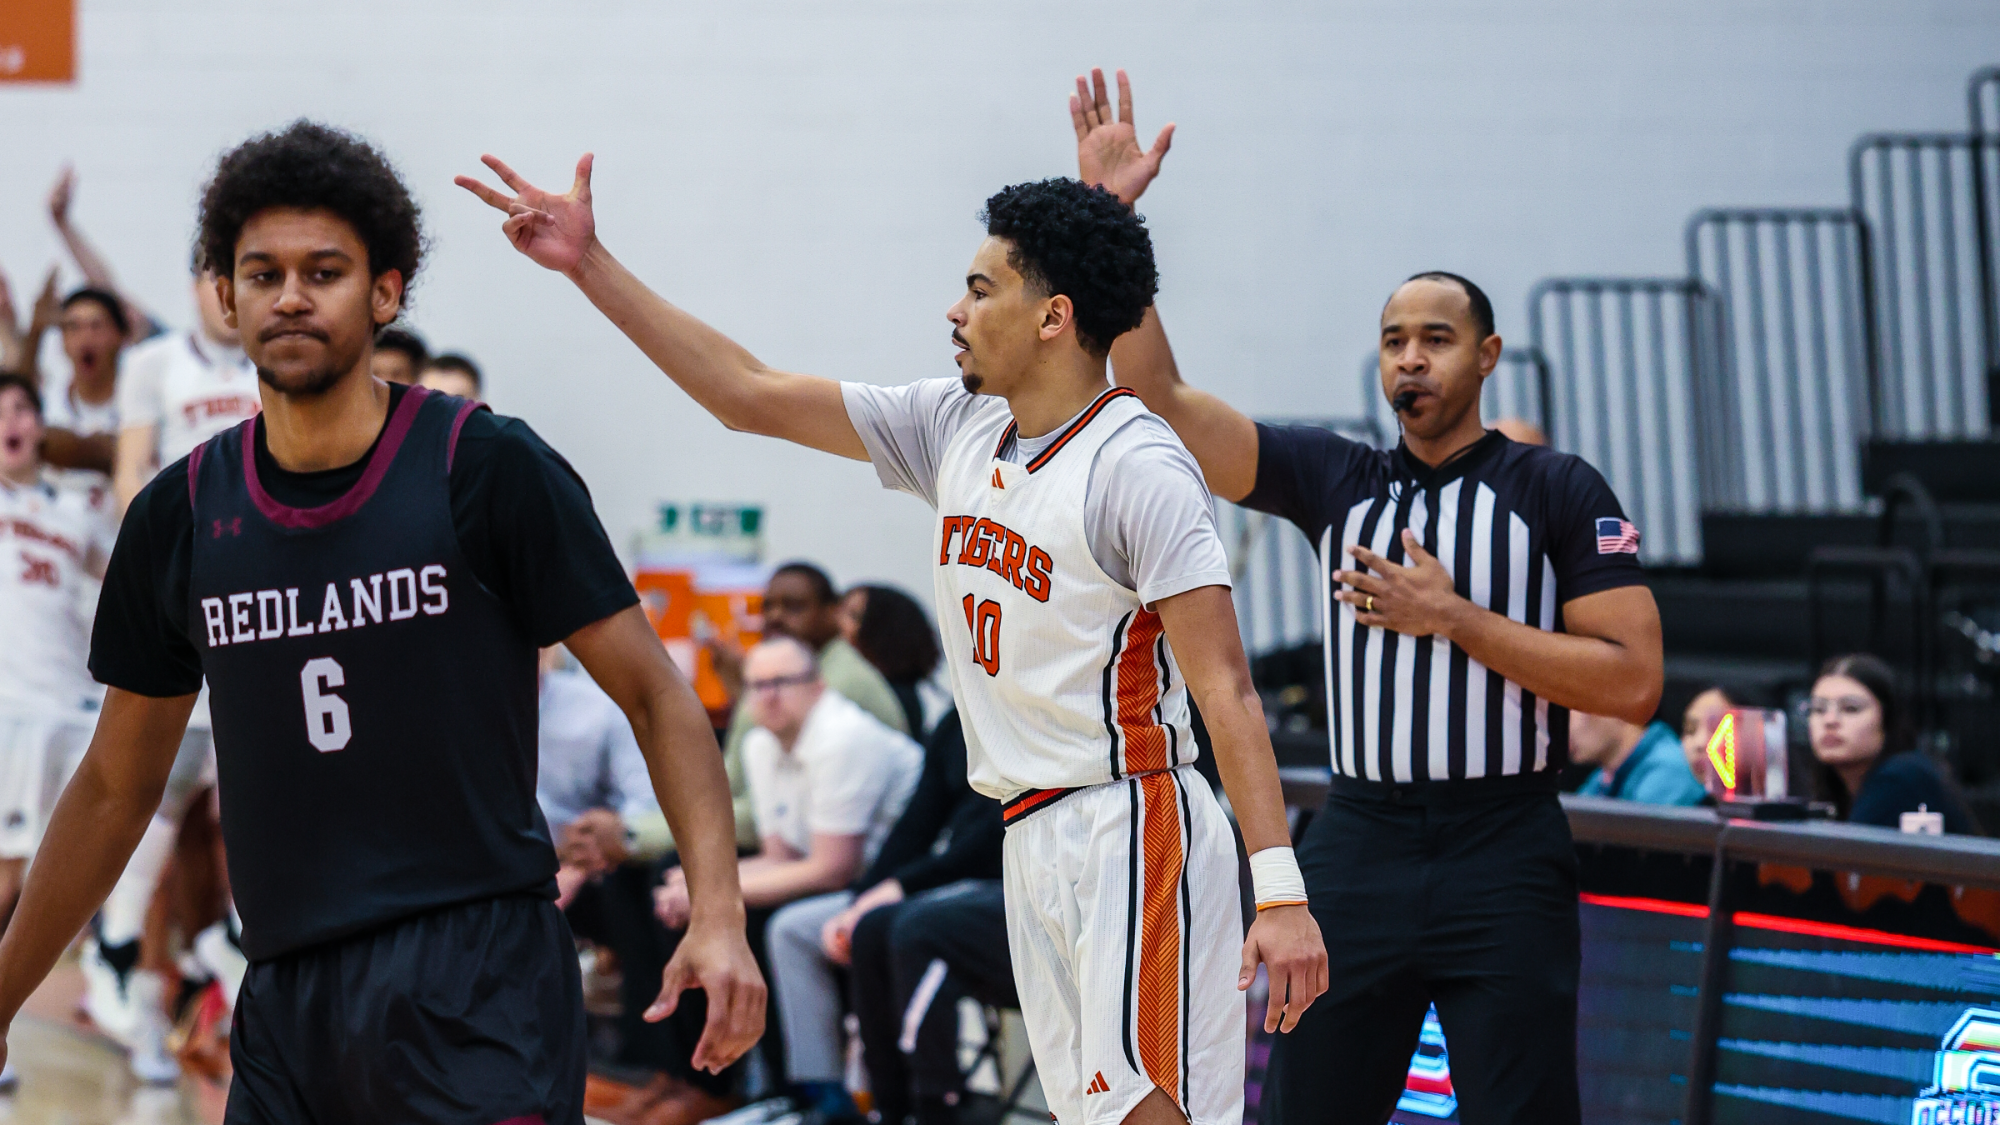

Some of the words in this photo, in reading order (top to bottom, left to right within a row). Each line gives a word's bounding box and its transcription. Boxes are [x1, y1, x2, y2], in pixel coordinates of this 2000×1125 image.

[940, 515, 1053, 603] TIGERS
[201, 564, 449, 647] REDLANDS
[962, 592, 1002, 677] 10
[300, 656, 352, 753] 6
